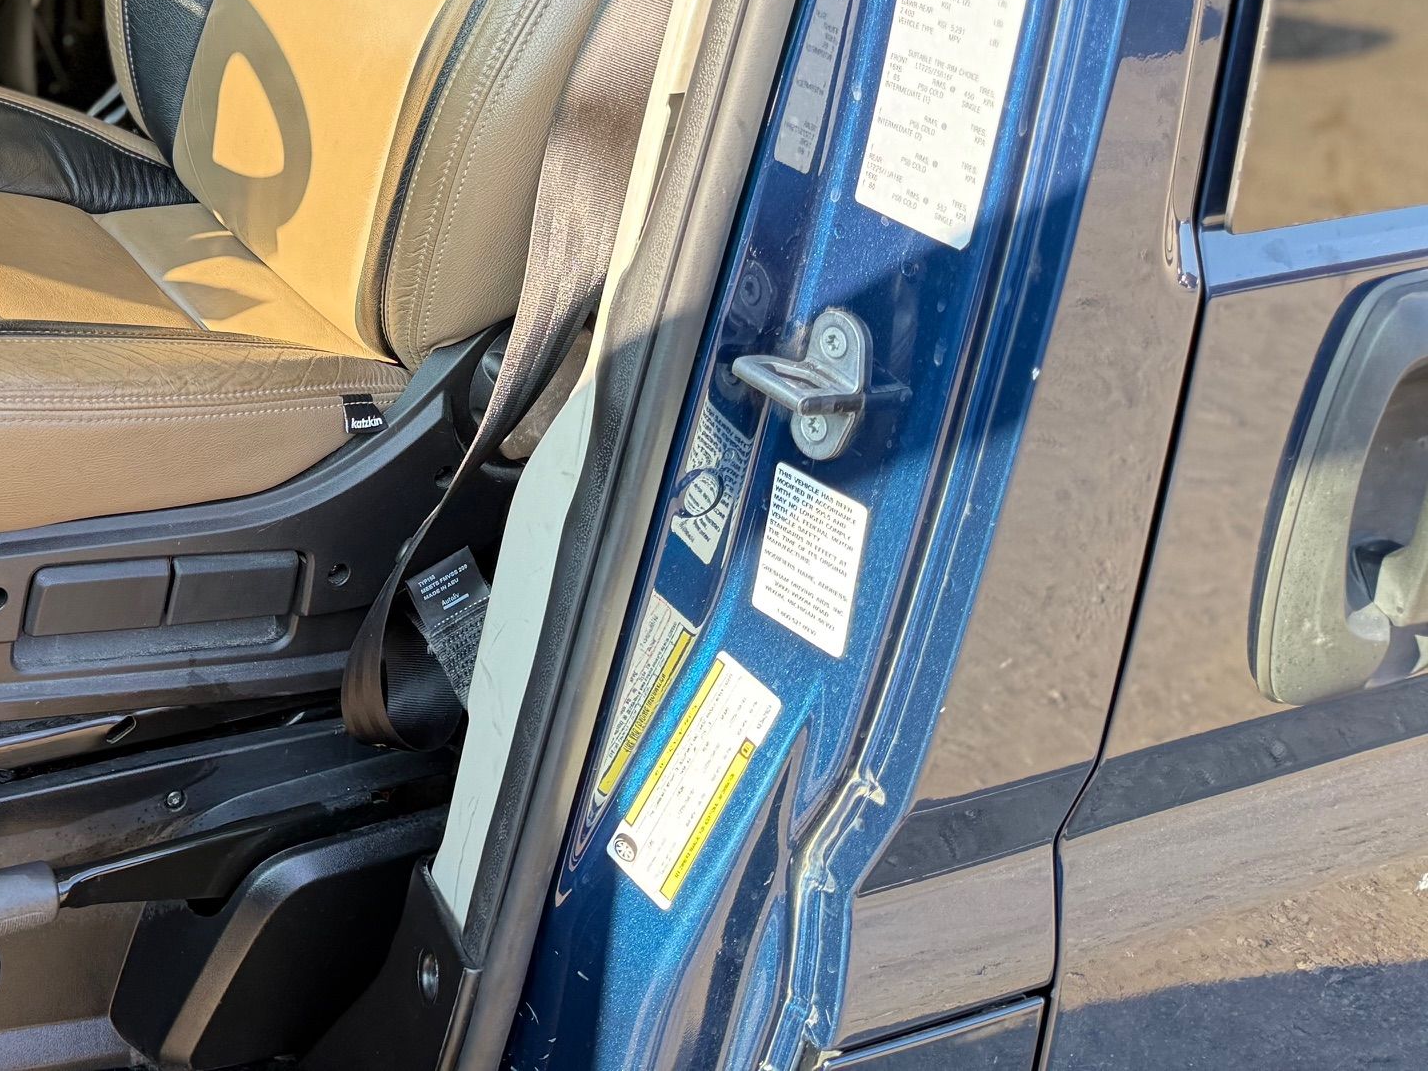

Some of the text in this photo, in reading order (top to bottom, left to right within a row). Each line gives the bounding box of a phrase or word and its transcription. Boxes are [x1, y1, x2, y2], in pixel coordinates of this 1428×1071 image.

[897, 16, 961, 43] VEHICLE TYPE MPV
[890, 52, 907, 64] FRONT
[907, 49, 932, 64] SUITABLE
[958, 67, 979, 81] CHOICE
[928, 87, 944, 98] COLD
[961, 100, 980, 113] SINGLE
[982, 97, 994, 108] KPA
[920, 124, 935, 136] COLD
[973, 135, 985, 146] KPA
[868, 152, 882, 164] REAR
[911, 161, 926, 173] COLD
[964, 174, 976, 185] KPA
[902, 197, 917, 210] COLD
[933, 212, 953, 226] SINGLE
[351, 415, 383, 429] katzkin
[776, 476, 804, 496] MODIFIED
[806, 493, 813, 501] IN
[777, 468, 791, 480] THIS
[793, 476, 819, 495] VEHICLE
[820, 491, 833, 503] HAS
[772, 501, 787, 514] WITH
[789, 511, 800, 522] ALL
[773, 493, 786, 504] MAY
[788, 501, 797, 511] NO
[798, 507, 823, 525] LONGER
[774, 484, 846, 529] WITH 49 CFR AND
[768, 526, 779, 537] THE
[770, 509, 820, 542] VEHICLE SAFETY
[424, 589, 440, 600] MADE
